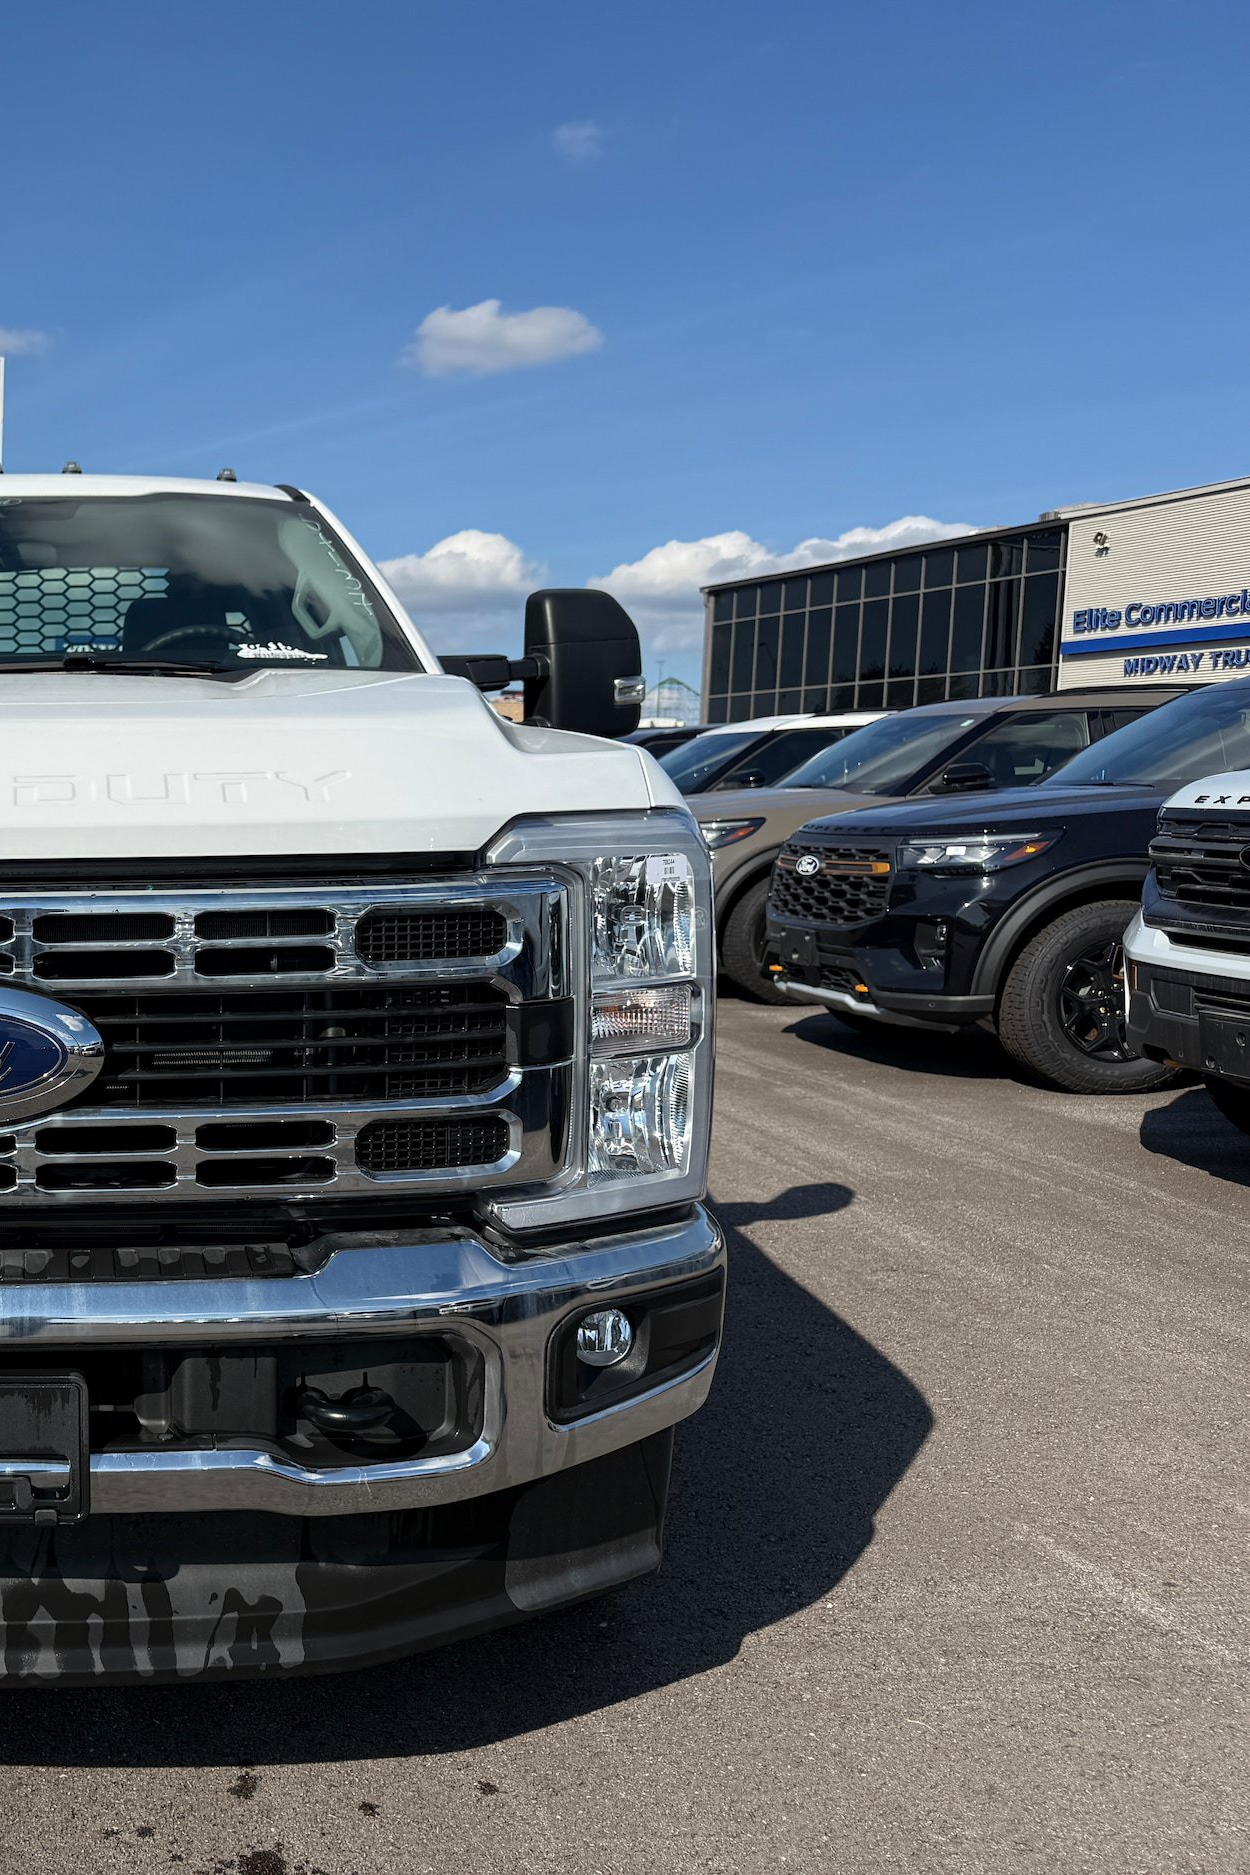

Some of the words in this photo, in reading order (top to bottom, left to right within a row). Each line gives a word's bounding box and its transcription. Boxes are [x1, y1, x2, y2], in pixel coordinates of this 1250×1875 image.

[1073, 607, 1122, 633] Elite
[1123, 653, 1204, 677] MIDWAY
[1209, 649, 1250, 670] TRU
[13, 770, 352, 806] DUTY
[1194, 795, 1250, 805] EXP
